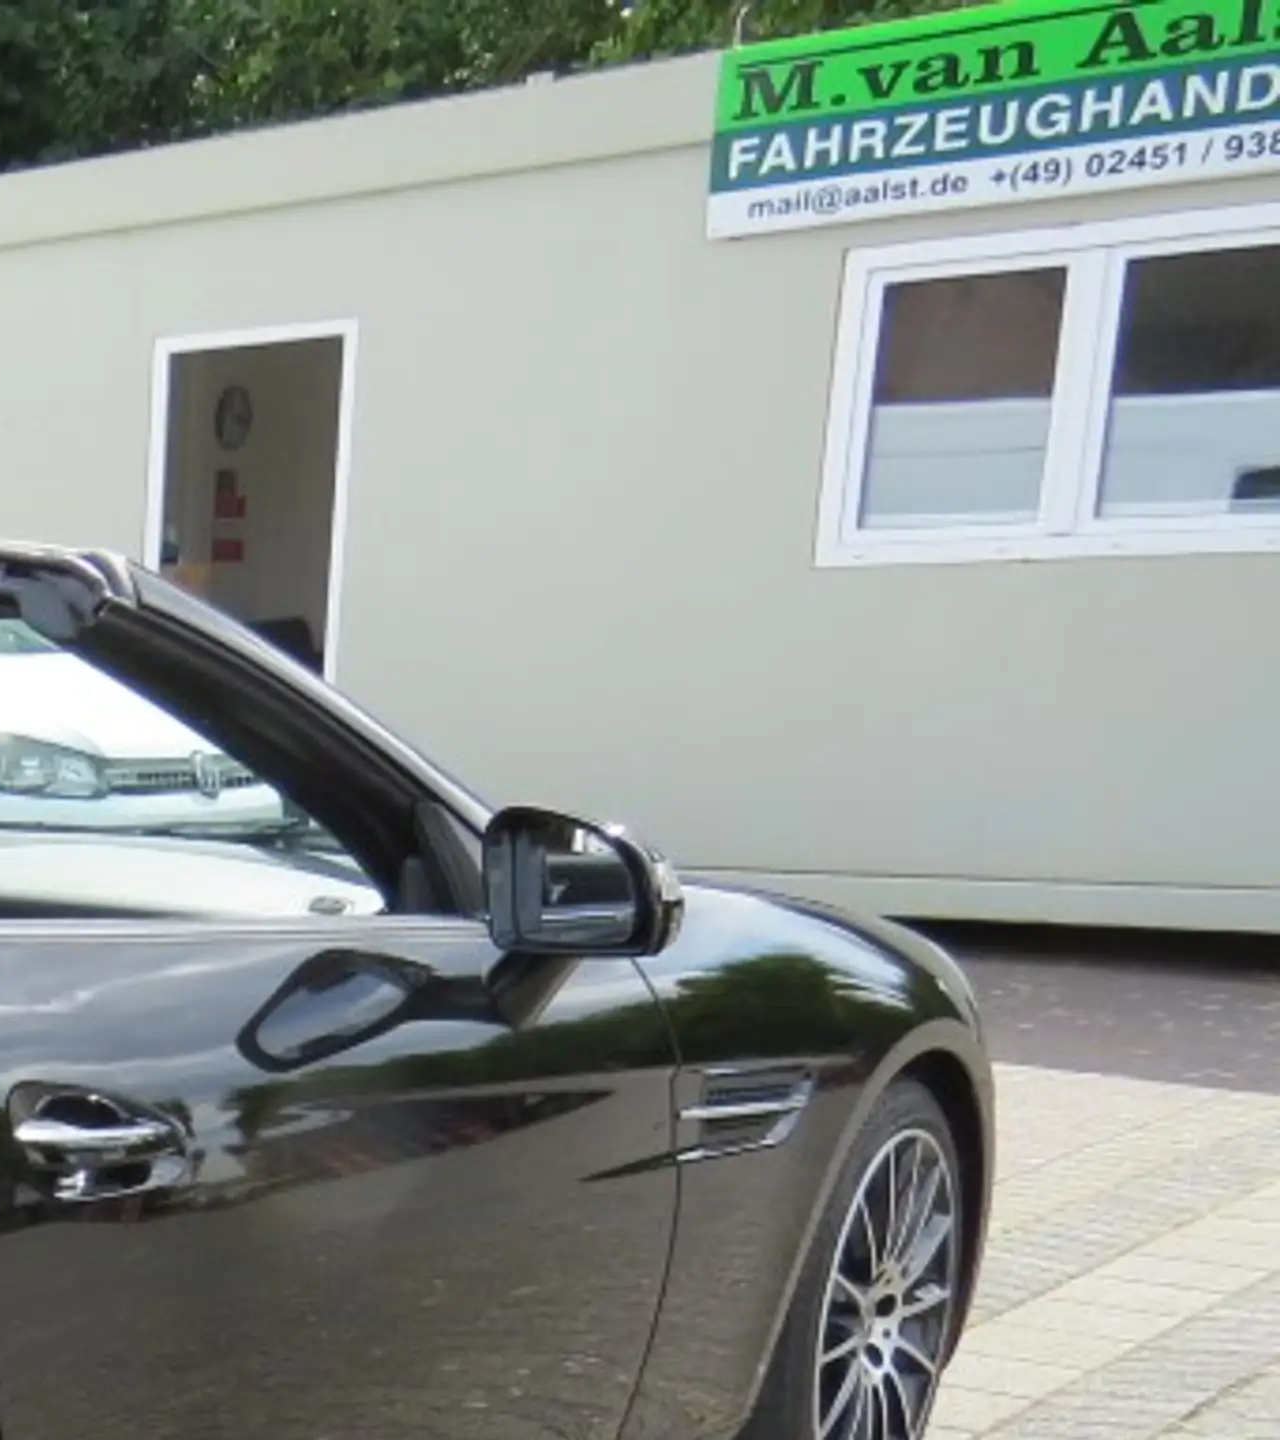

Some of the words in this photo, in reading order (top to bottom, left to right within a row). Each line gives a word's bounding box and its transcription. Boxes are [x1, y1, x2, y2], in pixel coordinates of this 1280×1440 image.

[1075, 0, 1280, 68] Aal
[728, 64, 1280, 181] FAHRZEUGHAND
[747, 173, 969, 219] mail@aalst.de
[1085, 142, 1188, 178] 02451
